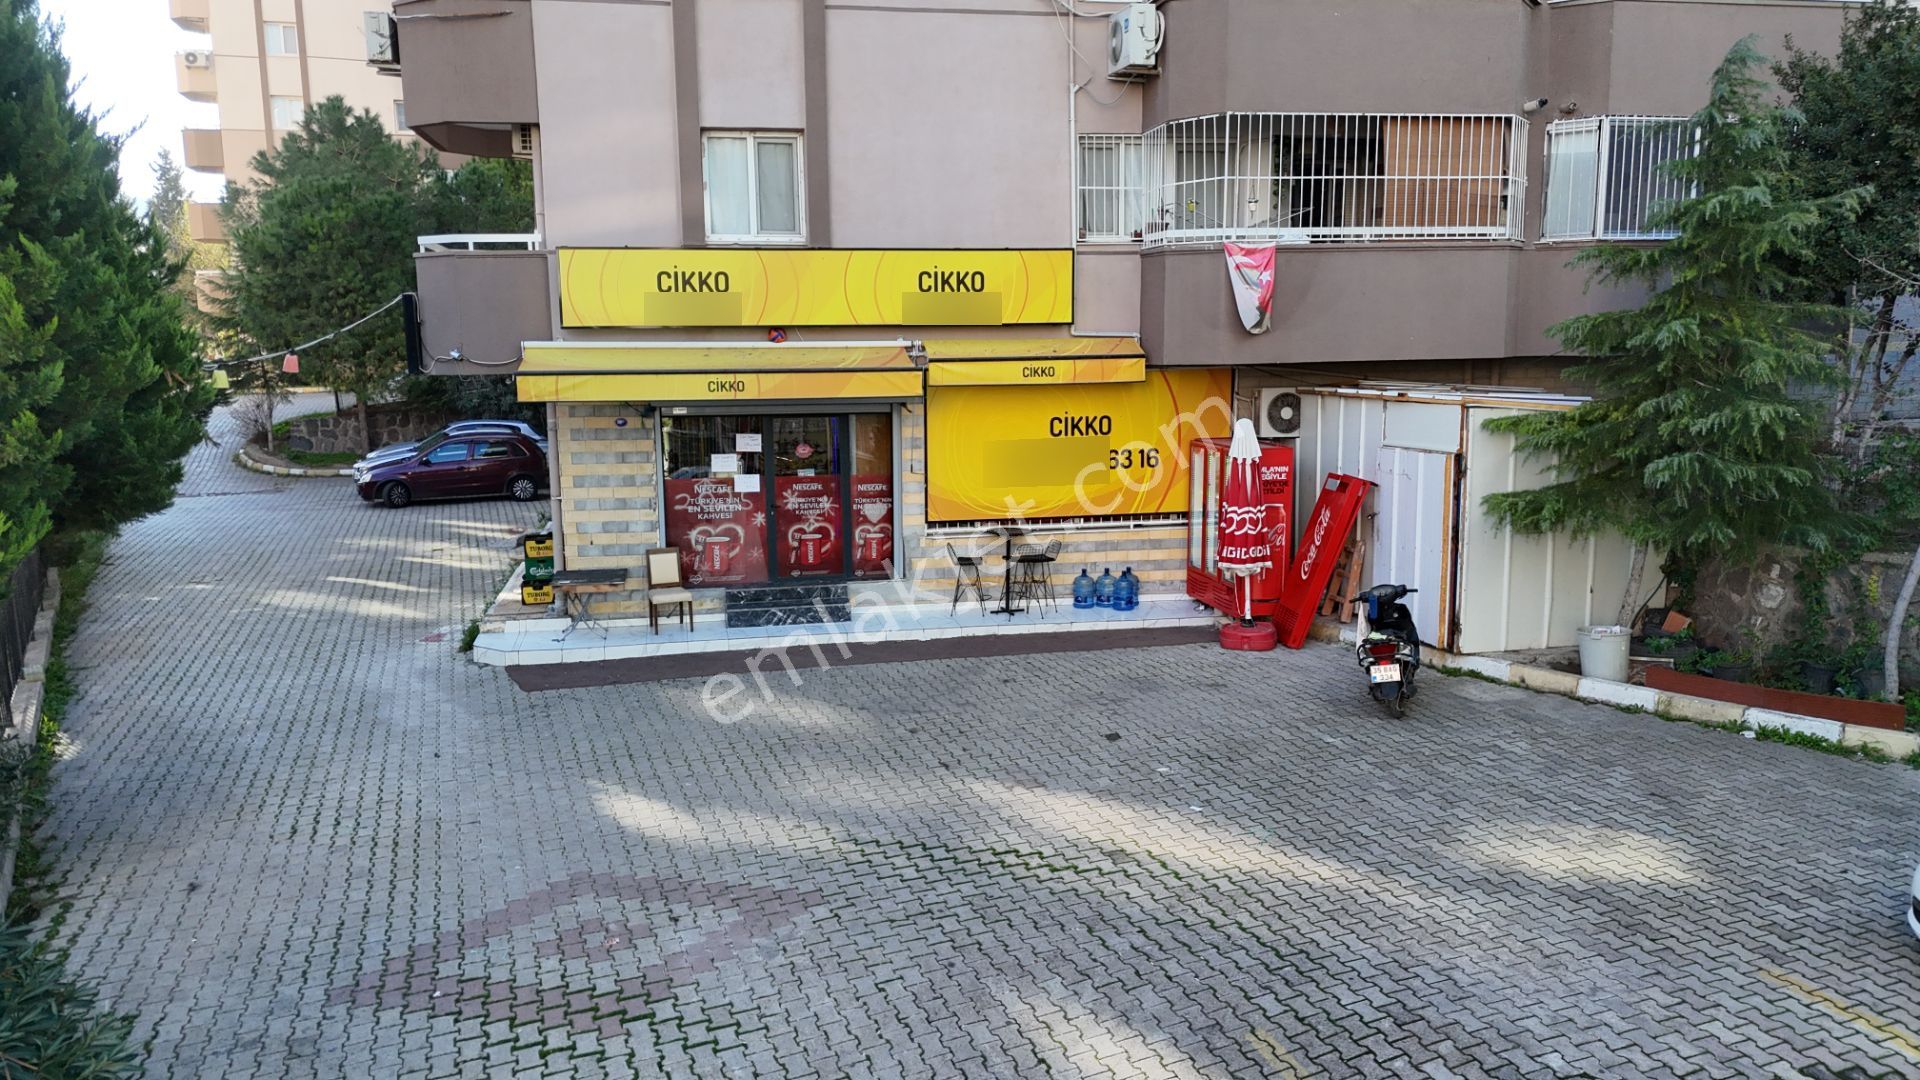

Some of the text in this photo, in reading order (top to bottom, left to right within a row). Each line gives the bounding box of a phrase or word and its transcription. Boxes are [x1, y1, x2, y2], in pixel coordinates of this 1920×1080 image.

[656, 264, 729, 293] CİKKO
[918, 264, 985, 293] CİKKO
[1022, 363, 1055, 378] CİKKO
[707, 377, 745, 393] CİKKO
[1049, 411, 1112, 437] CİKKO
[1138, 447, 1160, 469] 16
[688, 505, 701, 513] EN
